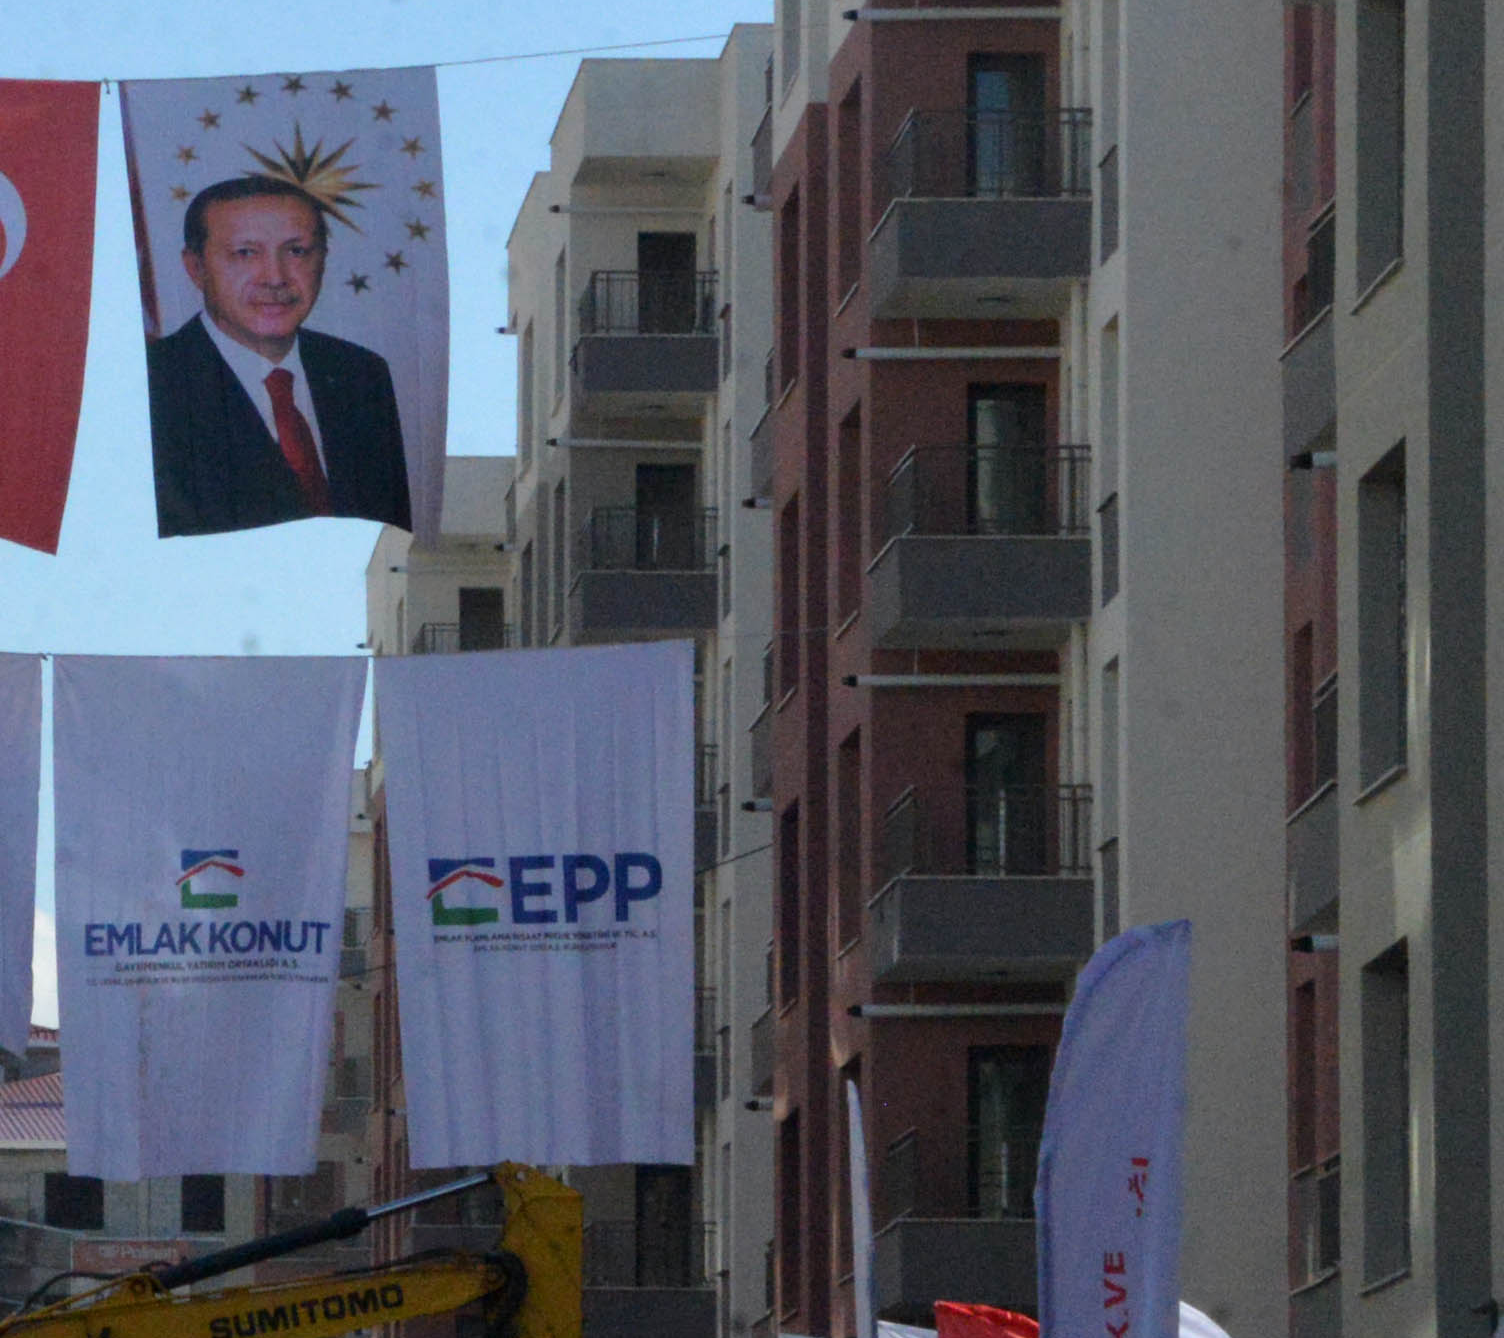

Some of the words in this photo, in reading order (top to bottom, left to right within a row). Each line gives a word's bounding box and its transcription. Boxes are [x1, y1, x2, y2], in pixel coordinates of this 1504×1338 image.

[509, 853, 663, 924] EPP
[85, 922, 202, 956] EMLAK
[209, 920, 331, 954] KONUT
